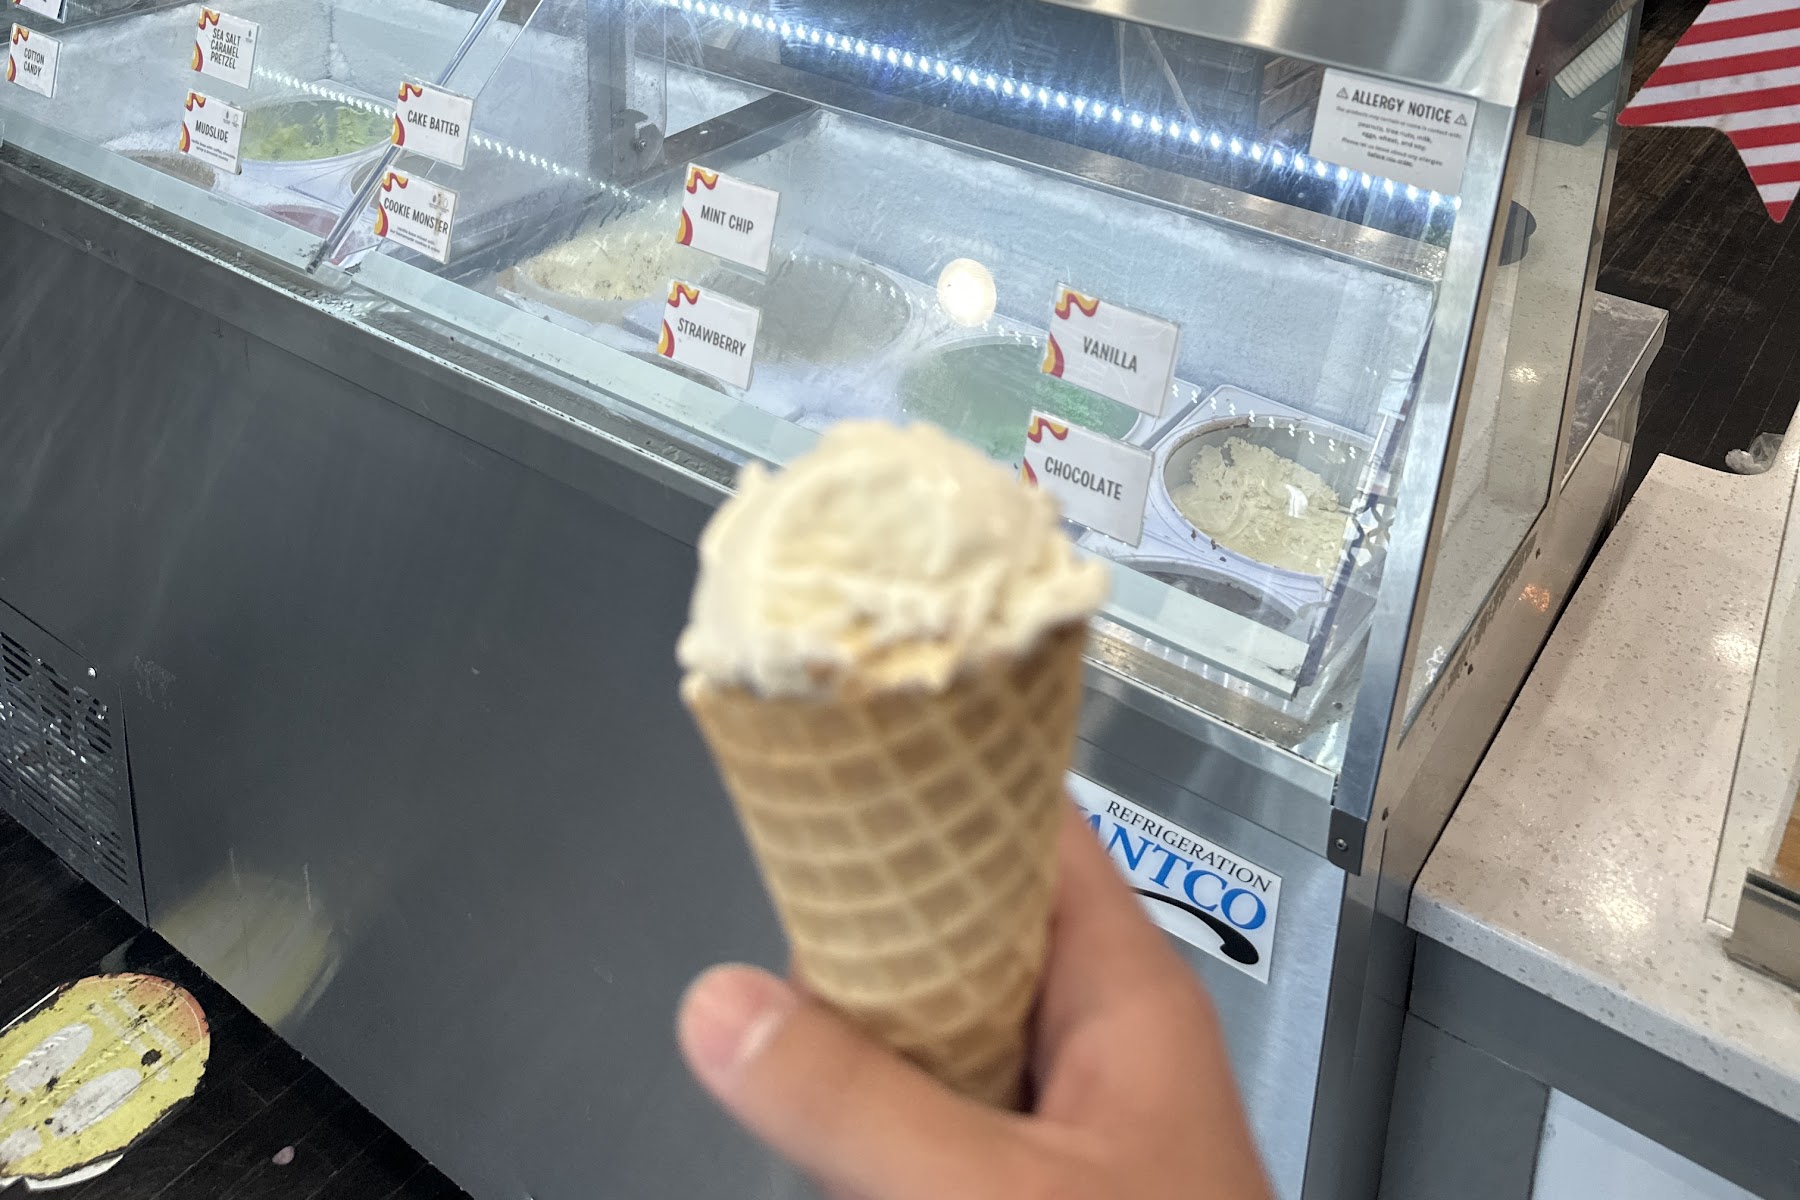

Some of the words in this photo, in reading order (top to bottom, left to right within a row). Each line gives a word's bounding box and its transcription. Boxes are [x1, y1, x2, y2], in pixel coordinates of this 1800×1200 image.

[211, 39, 239, 59] CARAMEL
[213, 27, 224, 41] SEA
[225, 31, 241, 47] SALT
[24, 48, 44, 65] COTTON
[24, 63, 42, 77] CANDY
[210, 50, 236, 70] PRETZEL
[1352, 89, 1404, 112] ALLERGY
[1408, 102, 1452, 124] NOTICE
[195, 120, 229, 143] MUDSLIDE
[407, 110, 427, 128] CAKE
[429, 118, 460, 137] BATTER
[384, 197, 410, 219] COOKIE
[412, 209, 448, 234] MONSTER
[700, 205, 726, 226] MINT
[729, 214, 754, 234] CHIP
[678, 317, 746, 357] STRAWBERRY
[1084, 336, 1137, 373] VANILLA
[1045, 456, 1123, 501] CHOCOLATE
[1106, 800, 1272, 893] REFRIGERATION
